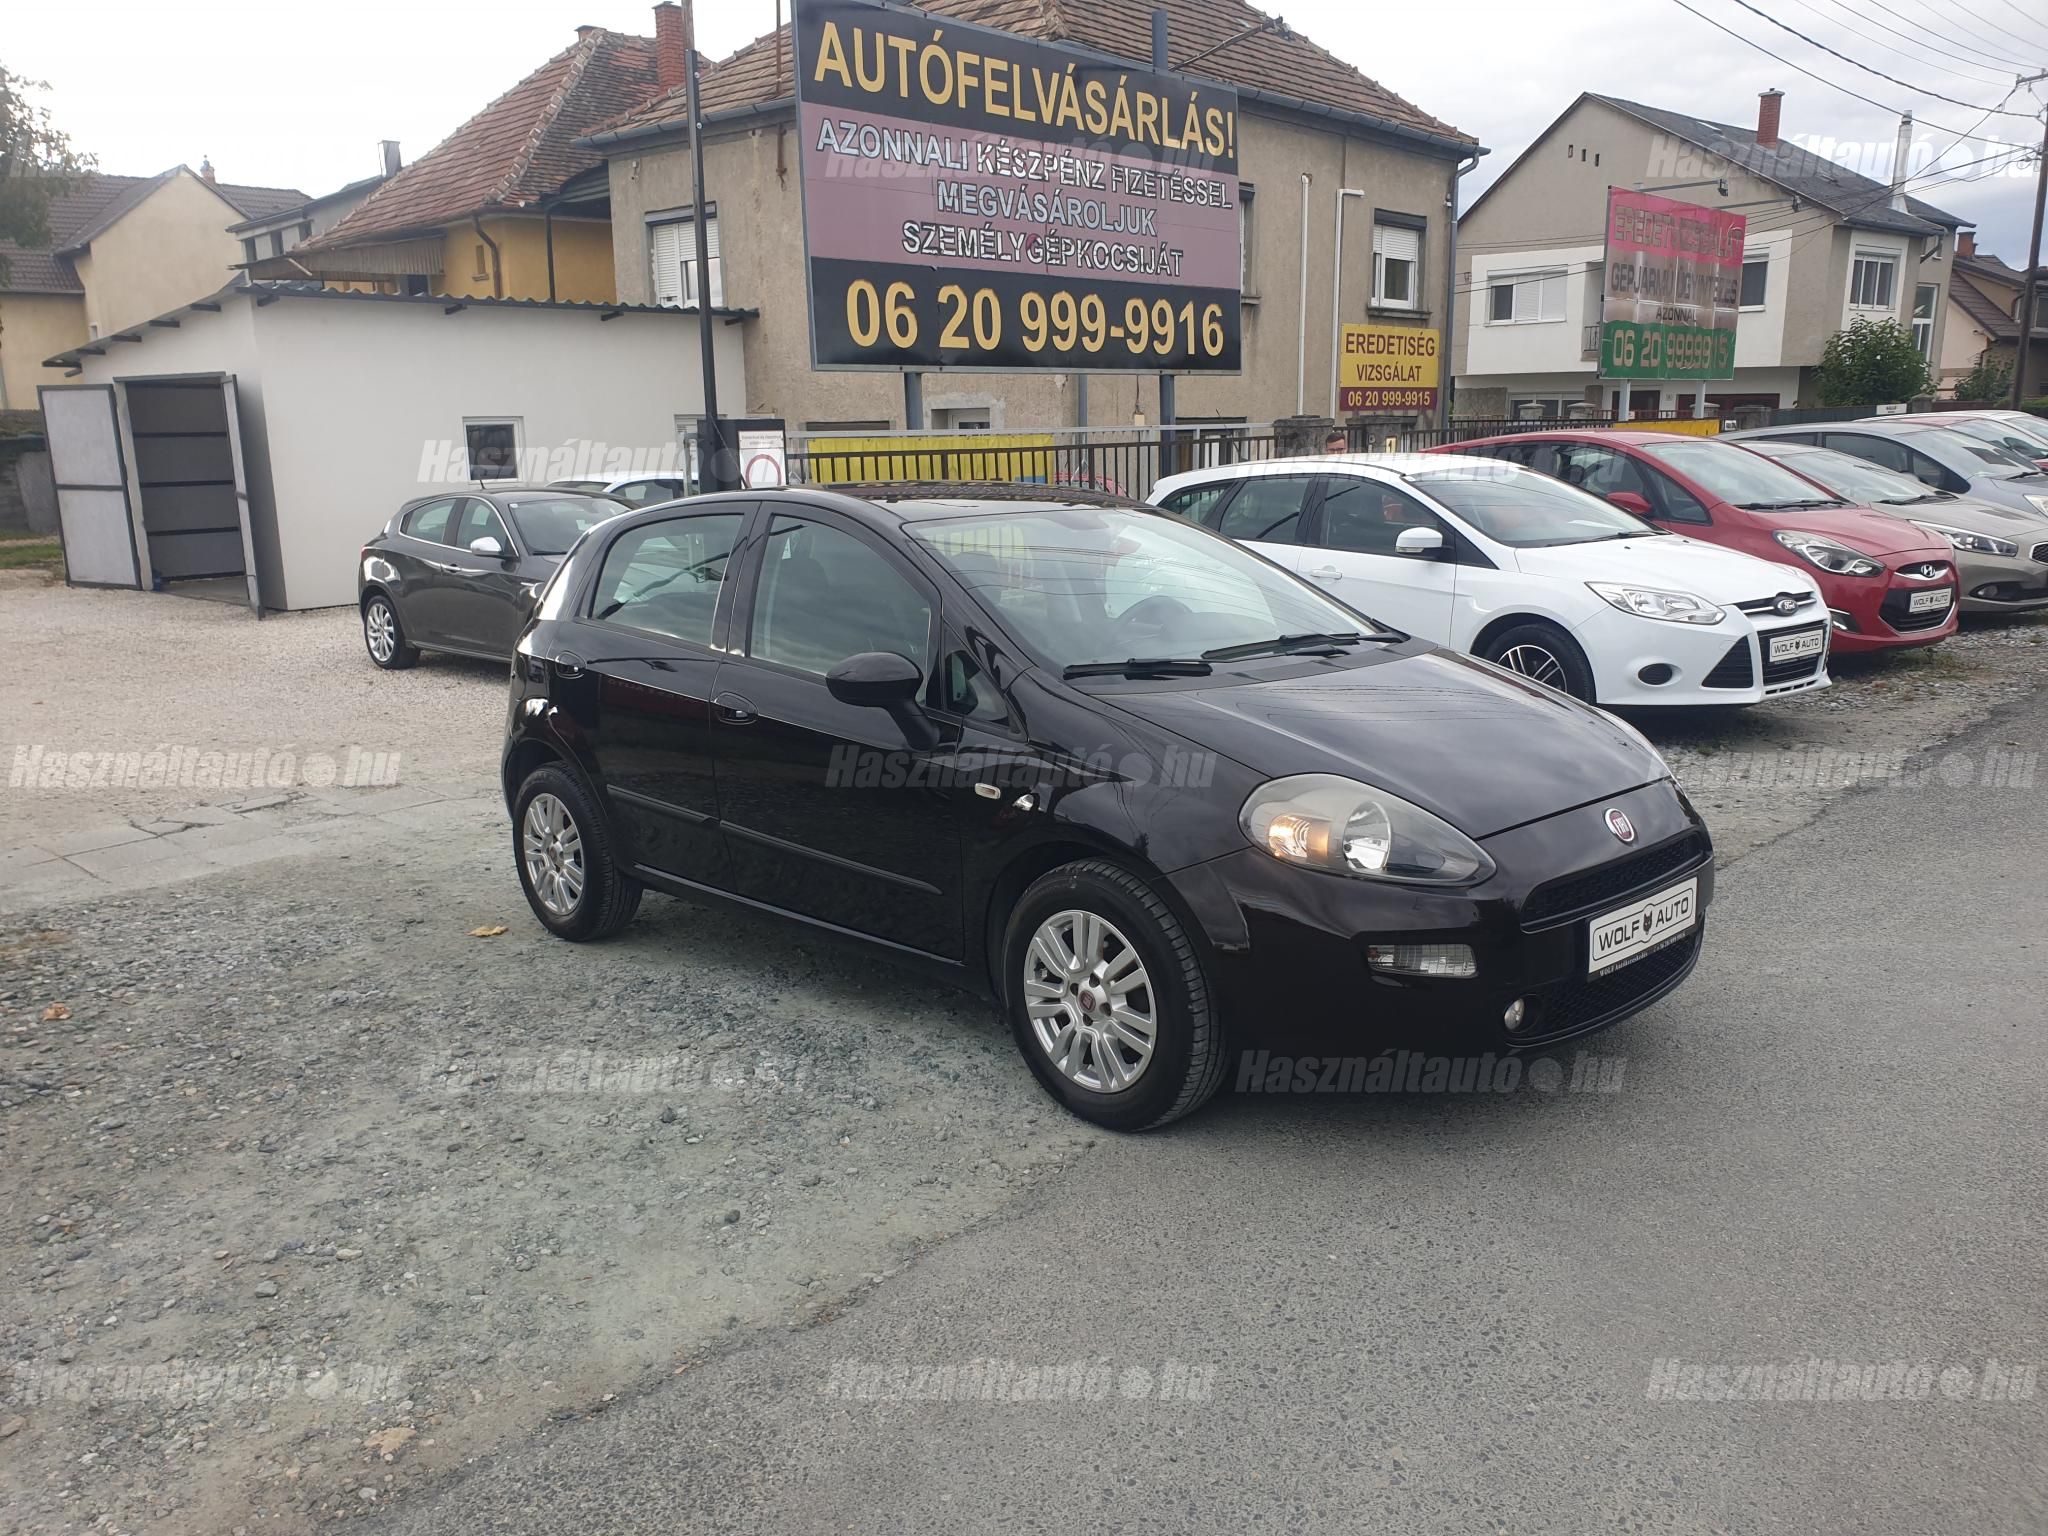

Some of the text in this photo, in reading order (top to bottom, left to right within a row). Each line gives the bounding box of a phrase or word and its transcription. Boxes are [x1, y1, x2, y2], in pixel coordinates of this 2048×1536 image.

[814, 20, 1235, 158] AUTÓFELVÁSÁRLÁS!
[816, 118, 1234, 209] AZONNALI KÉSZPÉNZ FIZETÉSSEL
[936, 179, 1157, 236] MEGVÁSÁROLJUK
[902, 220, 1183, 278] SZEMÉLYGÉPKOCSIJÁT
[845, 278, 1224, 357] 06 20 999-9916
[1345, 331, 1435, 356] EREDETISÉG
[1356, 361, 1422, 382] VIZSGÁLAT
[1613, 329, 1635, 367] 06
[1640, 330, 1661, 368] 20
[1348, 391, 1430, 407] 06 20 999-9915
[1774, 637, 1819, 654] WOLF AUTO
[1599, 919, 1640, 951] WOLF
[1656, 896, 1689, 928] AUTO
